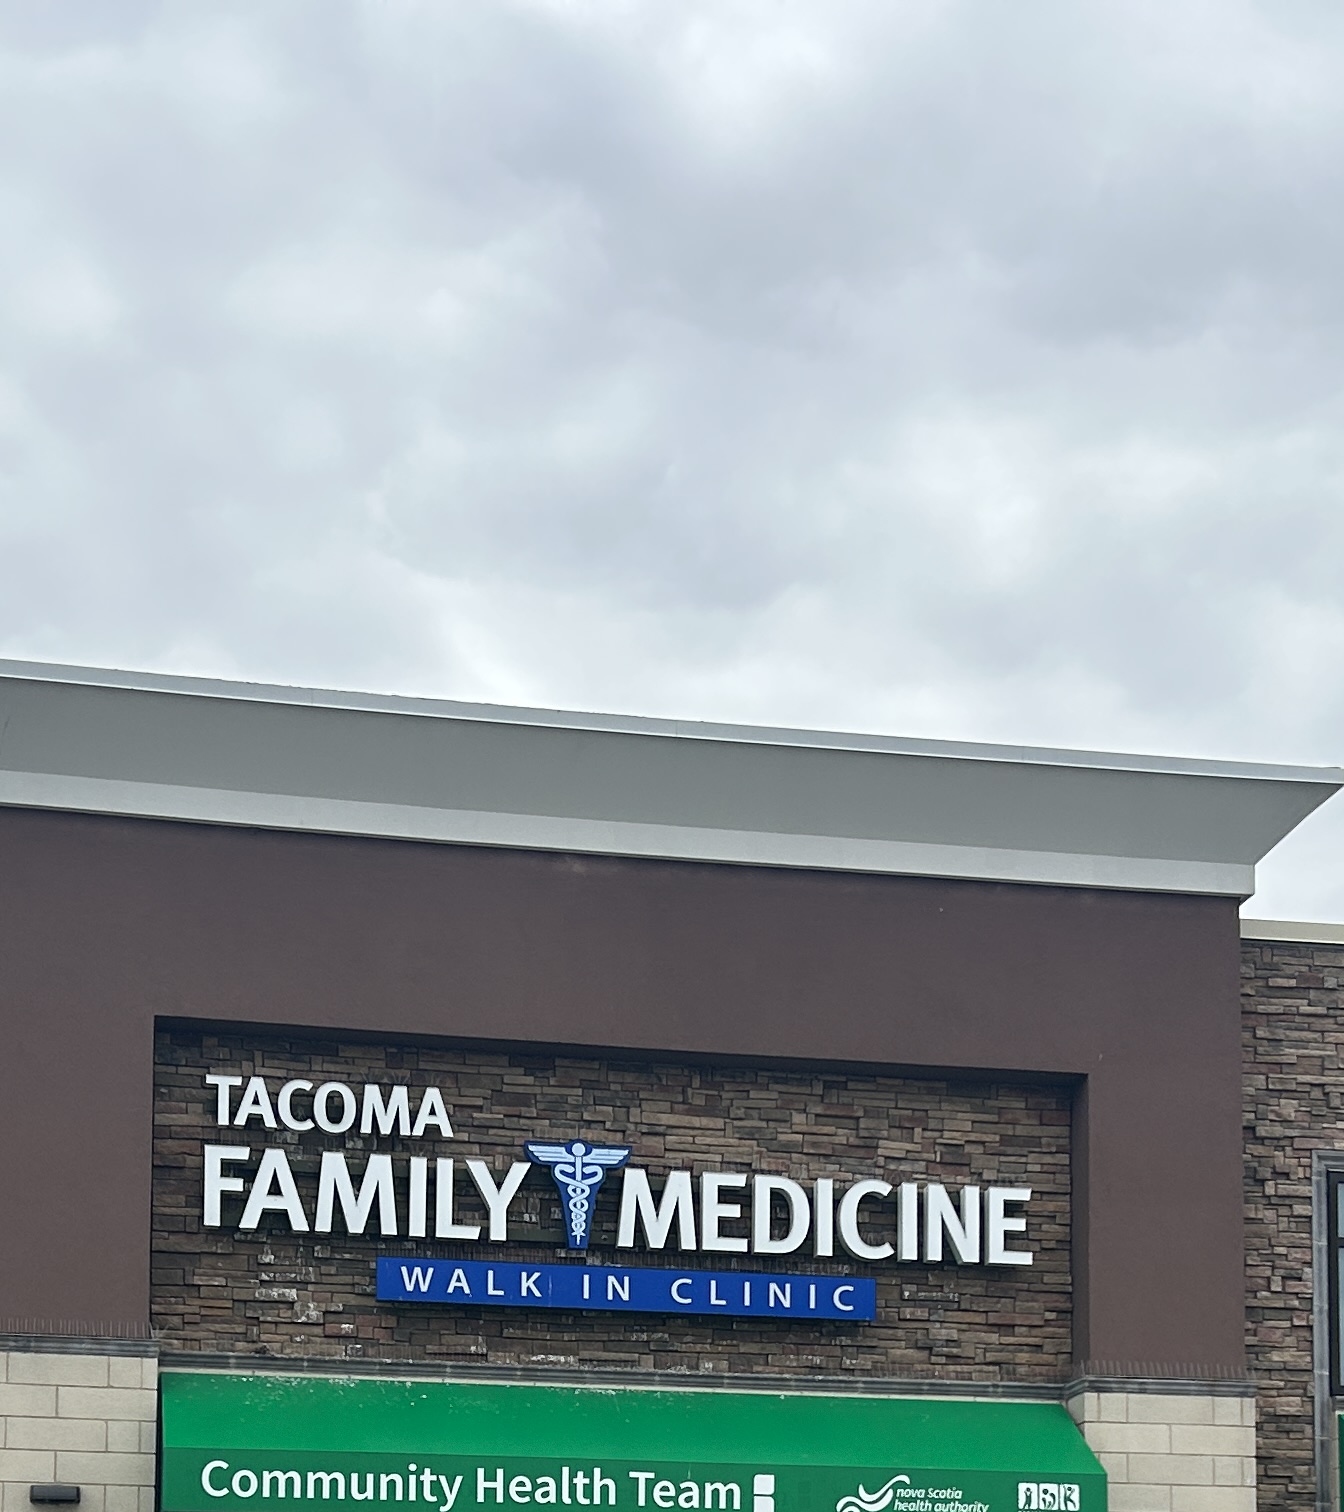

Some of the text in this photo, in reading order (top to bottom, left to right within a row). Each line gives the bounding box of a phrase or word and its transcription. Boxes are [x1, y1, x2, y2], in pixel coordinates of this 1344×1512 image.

[205, 1073, 453, 1138] TACOMA
[203, 1143, 1034, 1266] FAMILY MEDICINE
[401, 1266, 854, 1311] WALK IN CLINIC
[201, 1460, 741, 1512] Community Health Team
[894, 1501, 932, 1512] health
[896, 1488, 925, 1498] nova
